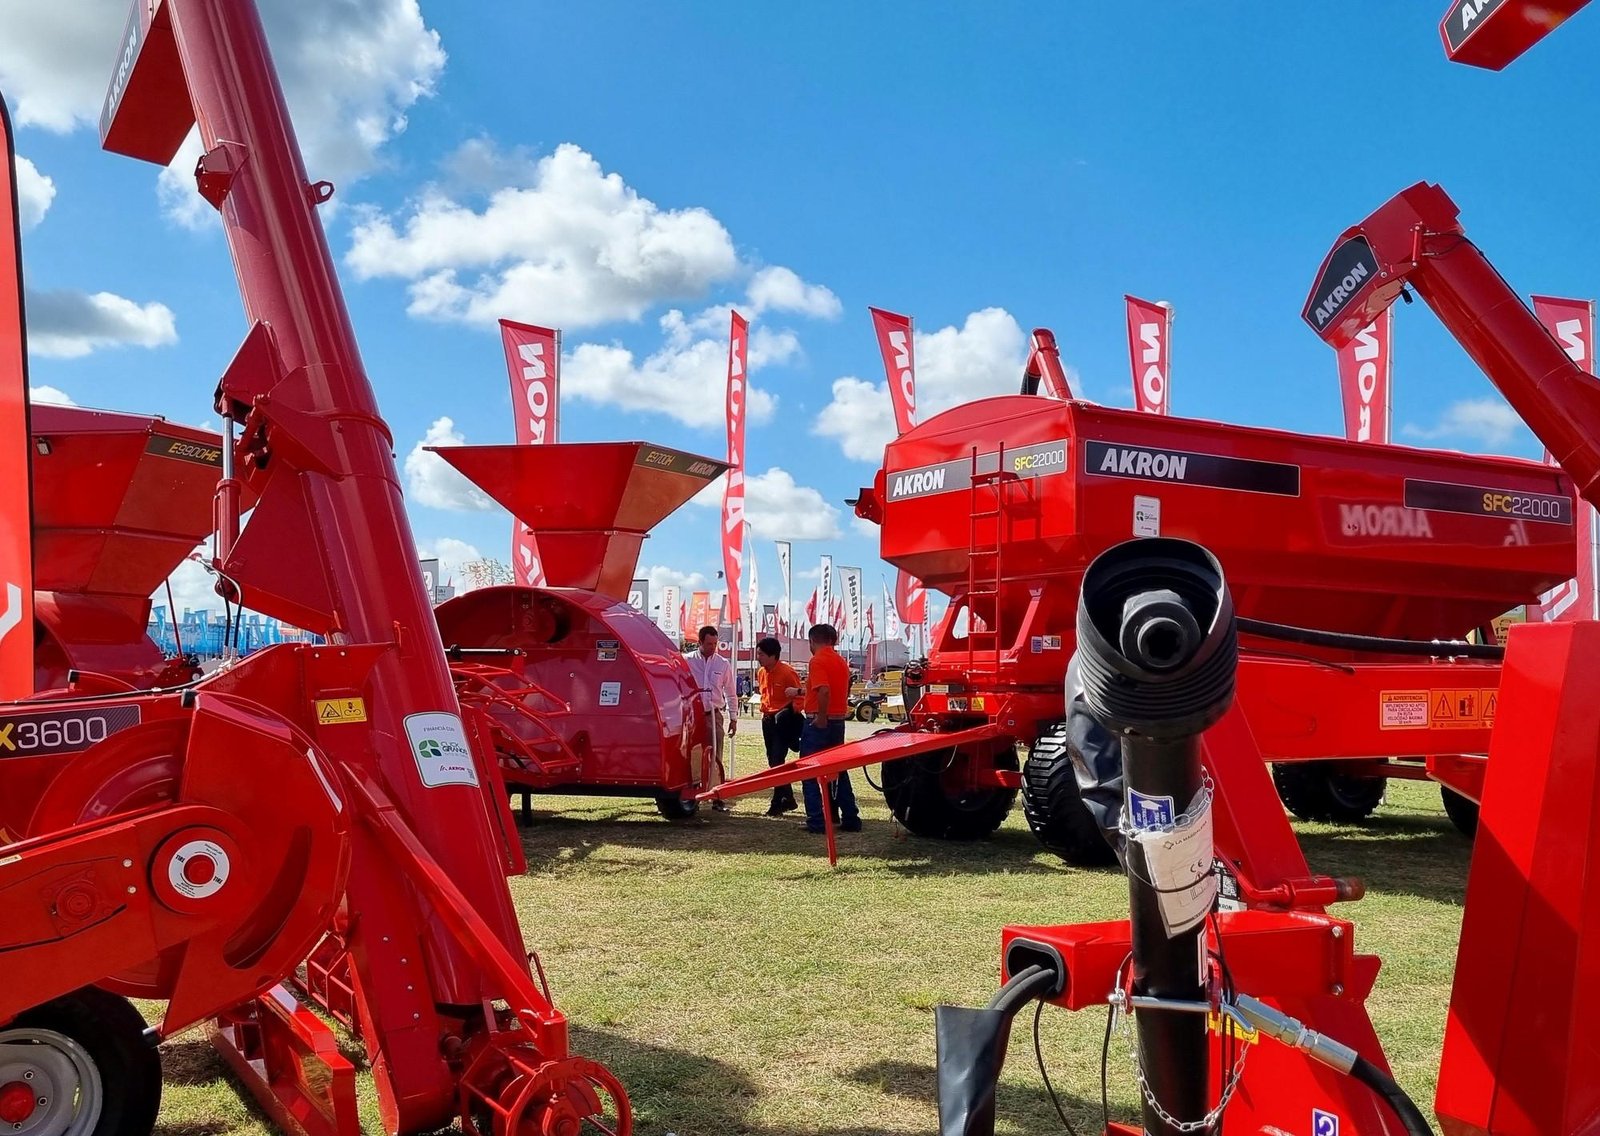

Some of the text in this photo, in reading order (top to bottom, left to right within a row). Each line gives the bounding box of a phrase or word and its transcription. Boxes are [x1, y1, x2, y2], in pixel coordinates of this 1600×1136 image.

[106, 26, 138, 118] AKRON
[1314, 261, 1369, 326] AKRON
[168, 442, 221, 462] E9900HE
[645, 451, 676, 466] E9700H
[1014, 450, 1064, 471] SFC22000
[1100, 447, 1188, 480] AKRON
[686, 461, 718, 476] AKRON
[893, 468, 946, 497] AKRON
[1483, 493, 1560, 519] SFC22000
[1190, 858, 1204, 873] CE
